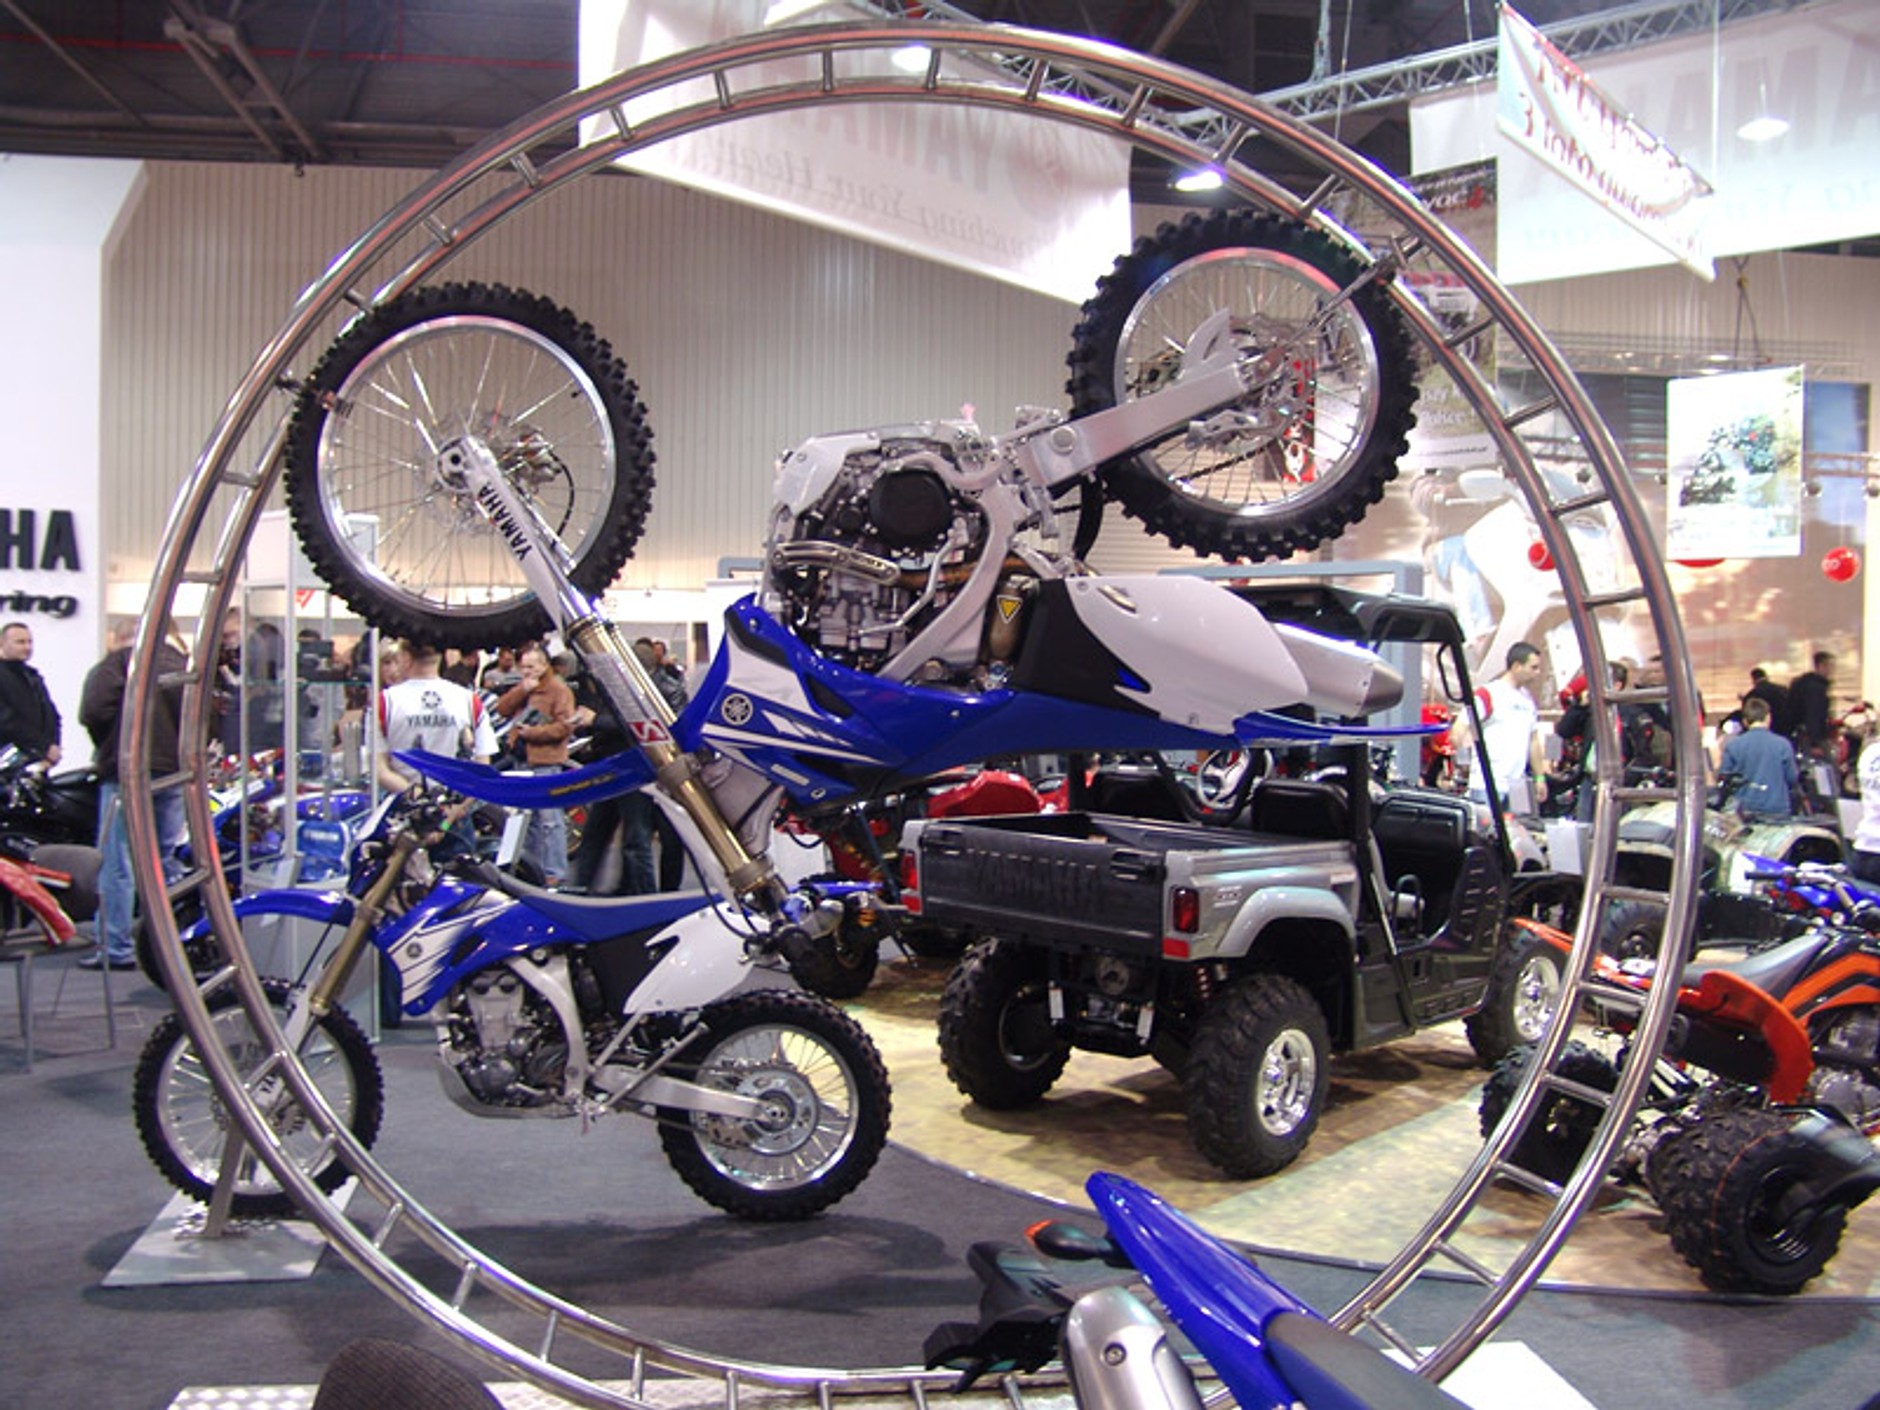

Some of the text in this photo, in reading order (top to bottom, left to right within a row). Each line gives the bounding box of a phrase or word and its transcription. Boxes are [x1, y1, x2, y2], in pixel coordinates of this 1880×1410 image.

[0, 508, 82, 571] HA
[477, 481, 532, 561] YAMAHA
[405, 714, 457, 728] YAMAHA
